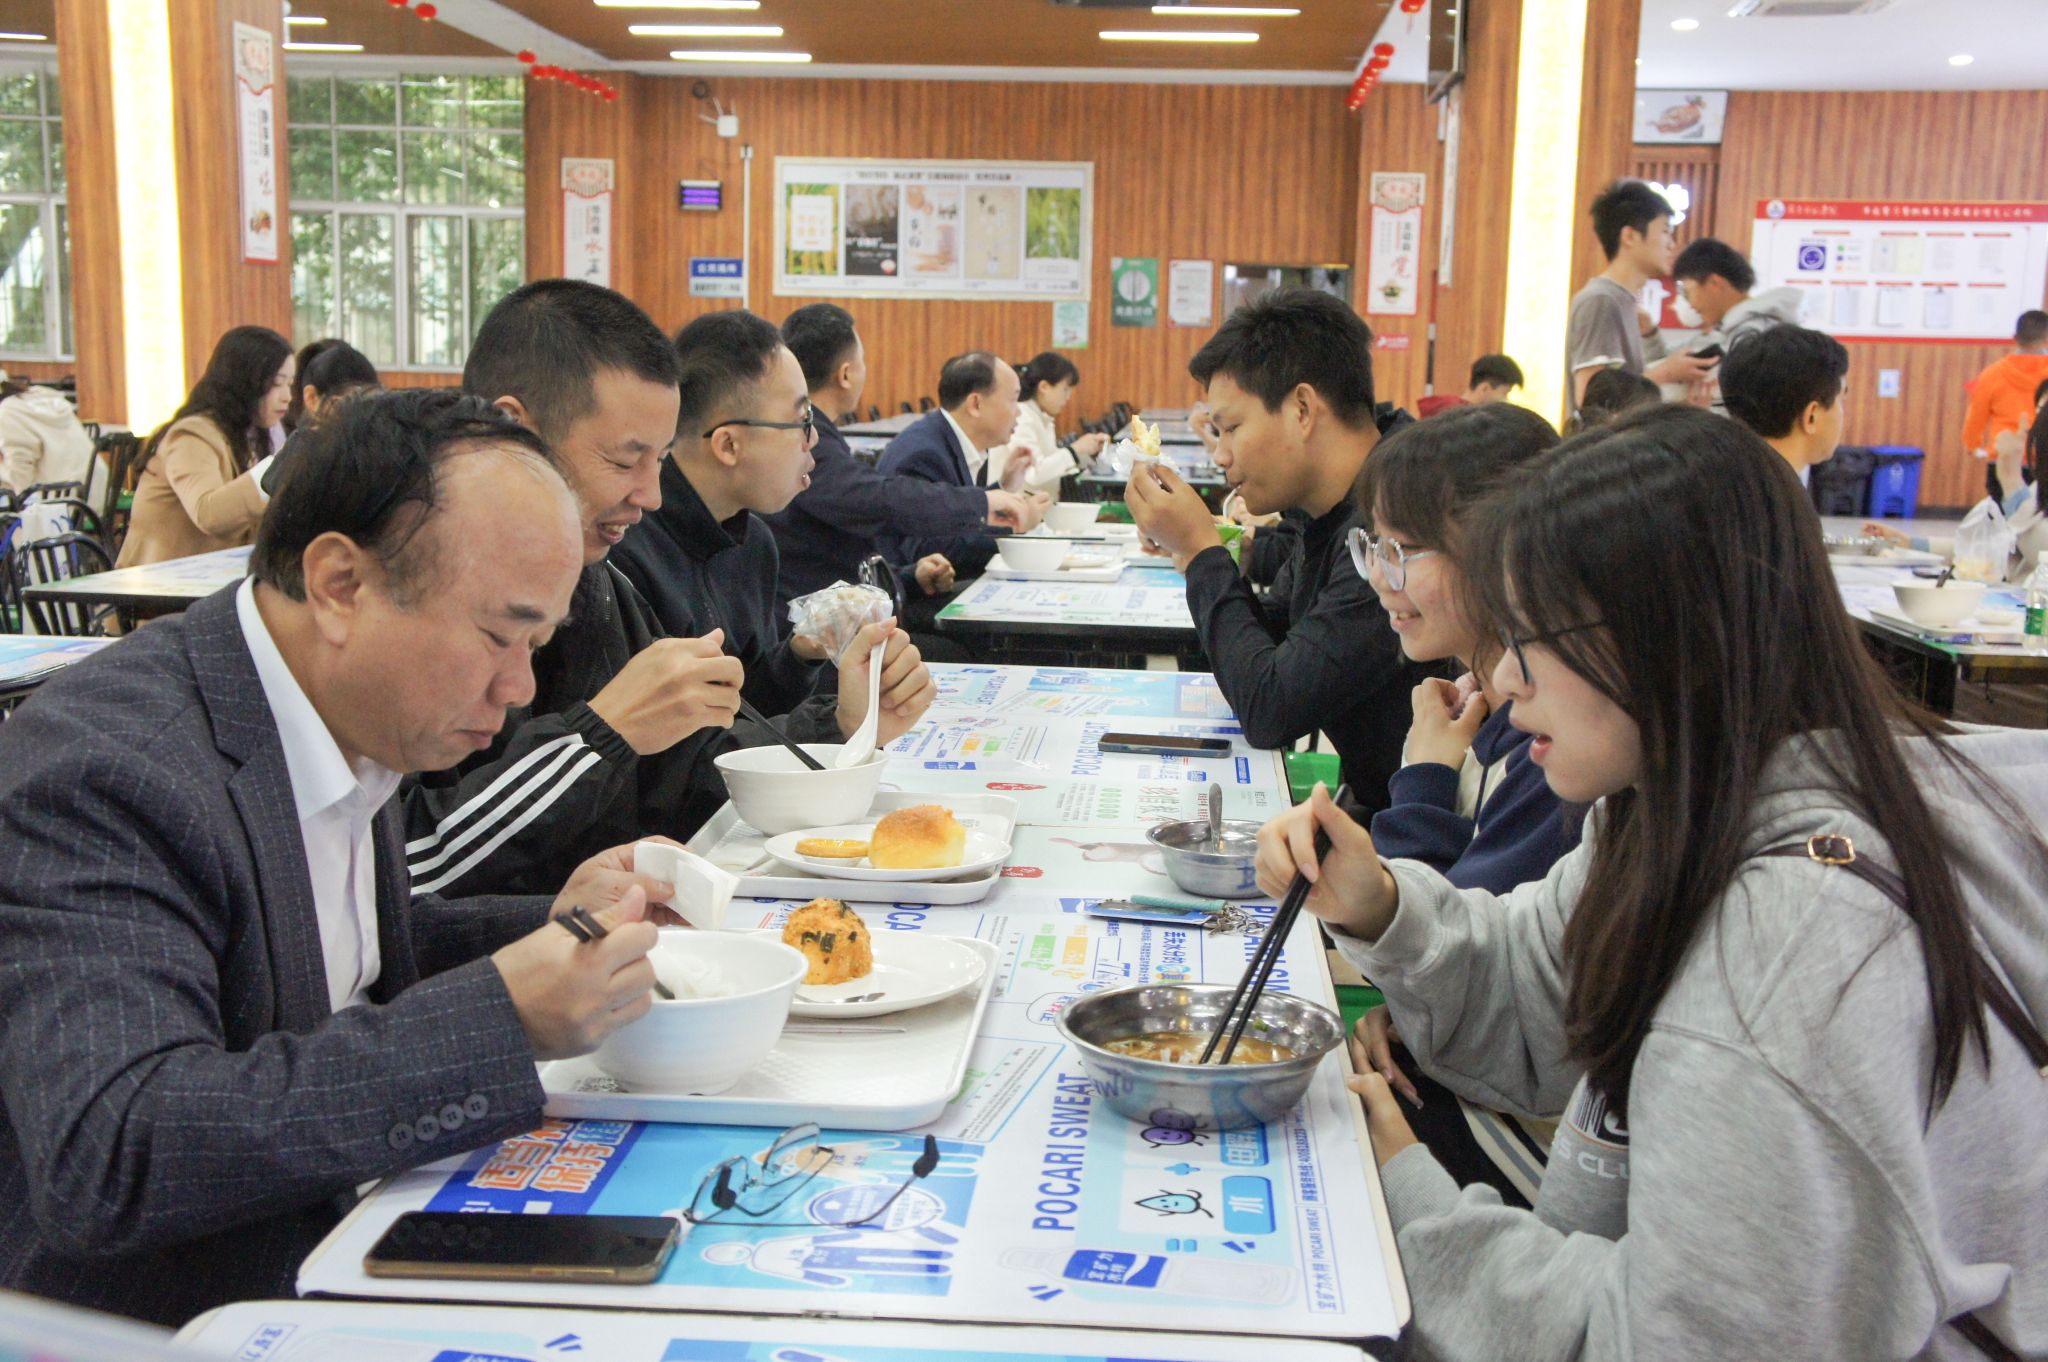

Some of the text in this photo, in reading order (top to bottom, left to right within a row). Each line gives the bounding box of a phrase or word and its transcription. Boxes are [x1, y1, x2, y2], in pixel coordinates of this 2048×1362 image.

[1048, 1073, 1092, 1138] SWEAT
[1032, 1144, 1085, 1231] POCARI
[1228, 1195, 1265, 1215] 水
[1305, 1207, 1321, 1232] SWEAT
[1309, 1233, 1325, 1260] POCARI
